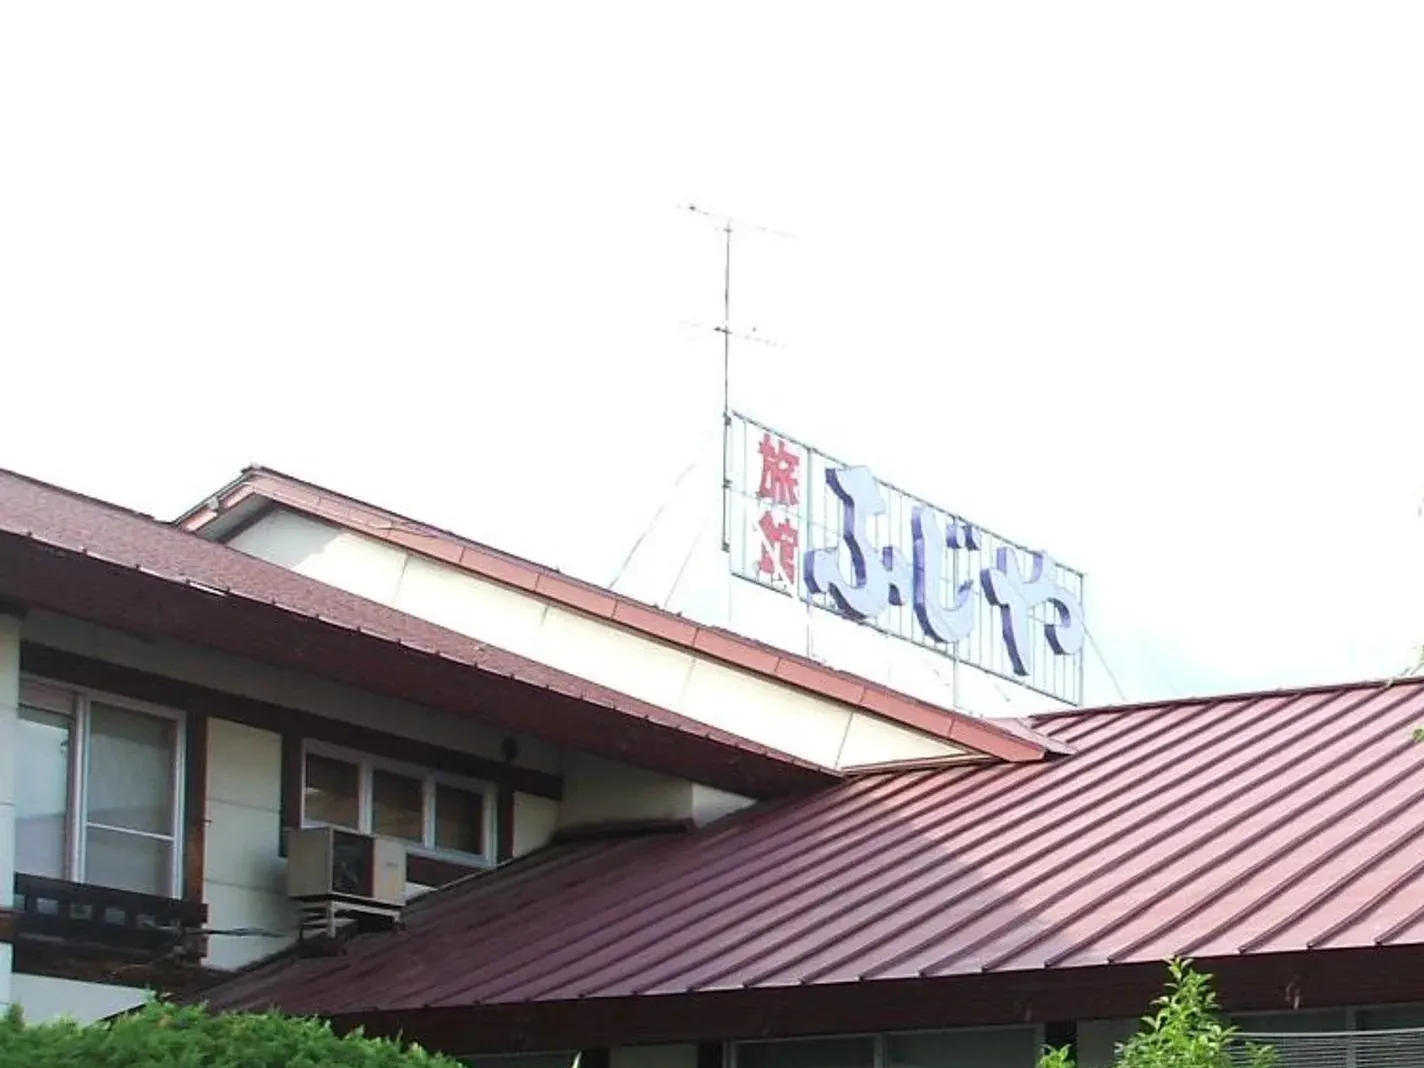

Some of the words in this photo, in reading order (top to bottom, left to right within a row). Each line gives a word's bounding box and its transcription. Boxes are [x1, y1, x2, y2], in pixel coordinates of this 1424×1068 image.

[757, 432, 800, 585] 旅館
[803, 465, 1084, 676] ふじや
